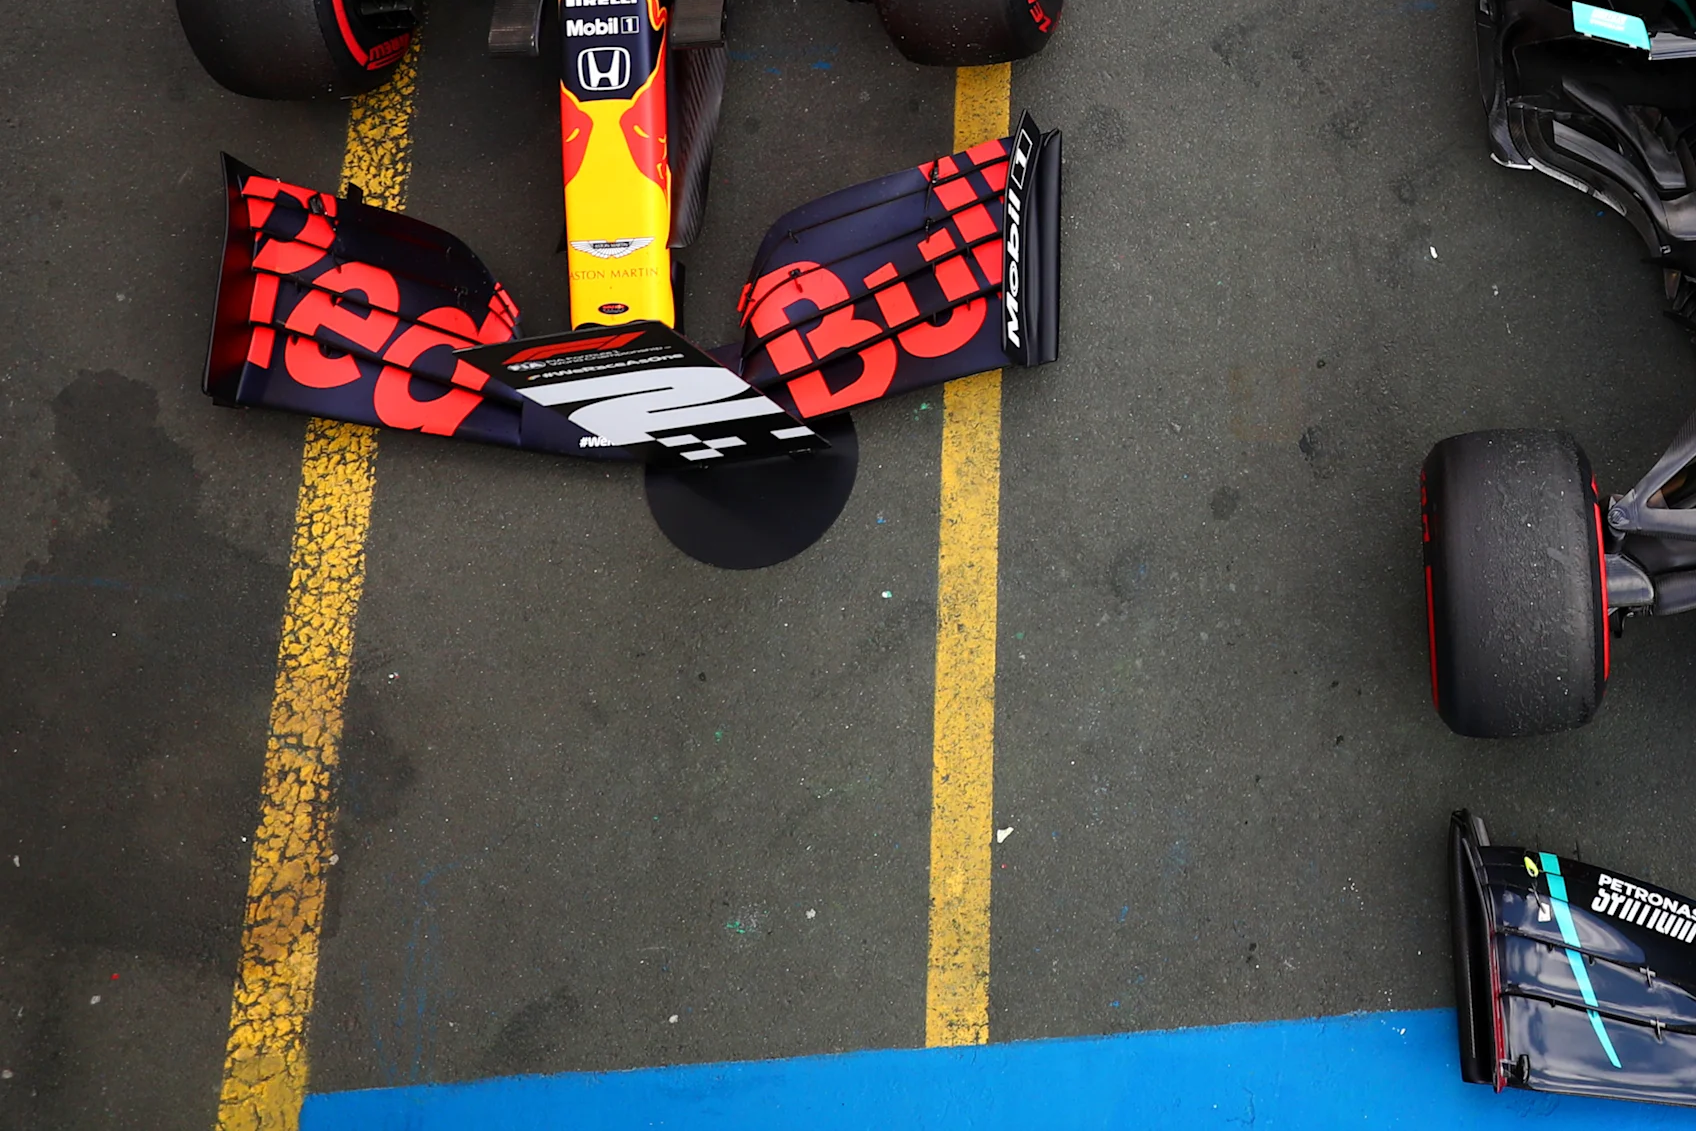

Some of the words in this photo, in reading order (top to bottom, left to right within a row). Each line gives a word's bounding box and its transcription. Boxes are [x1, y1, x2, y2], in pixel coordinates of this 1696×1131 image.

[566, 17, 619, 37] Mobil
[570, 270, 605, 281] ASTON
[611, 267, 660, 279] MARTIN
[1005, 189, 1022, 348] Mobil
[241, 176, 520, 436] Red
[542, 353, 685, 379] #WeRaceAsOne
